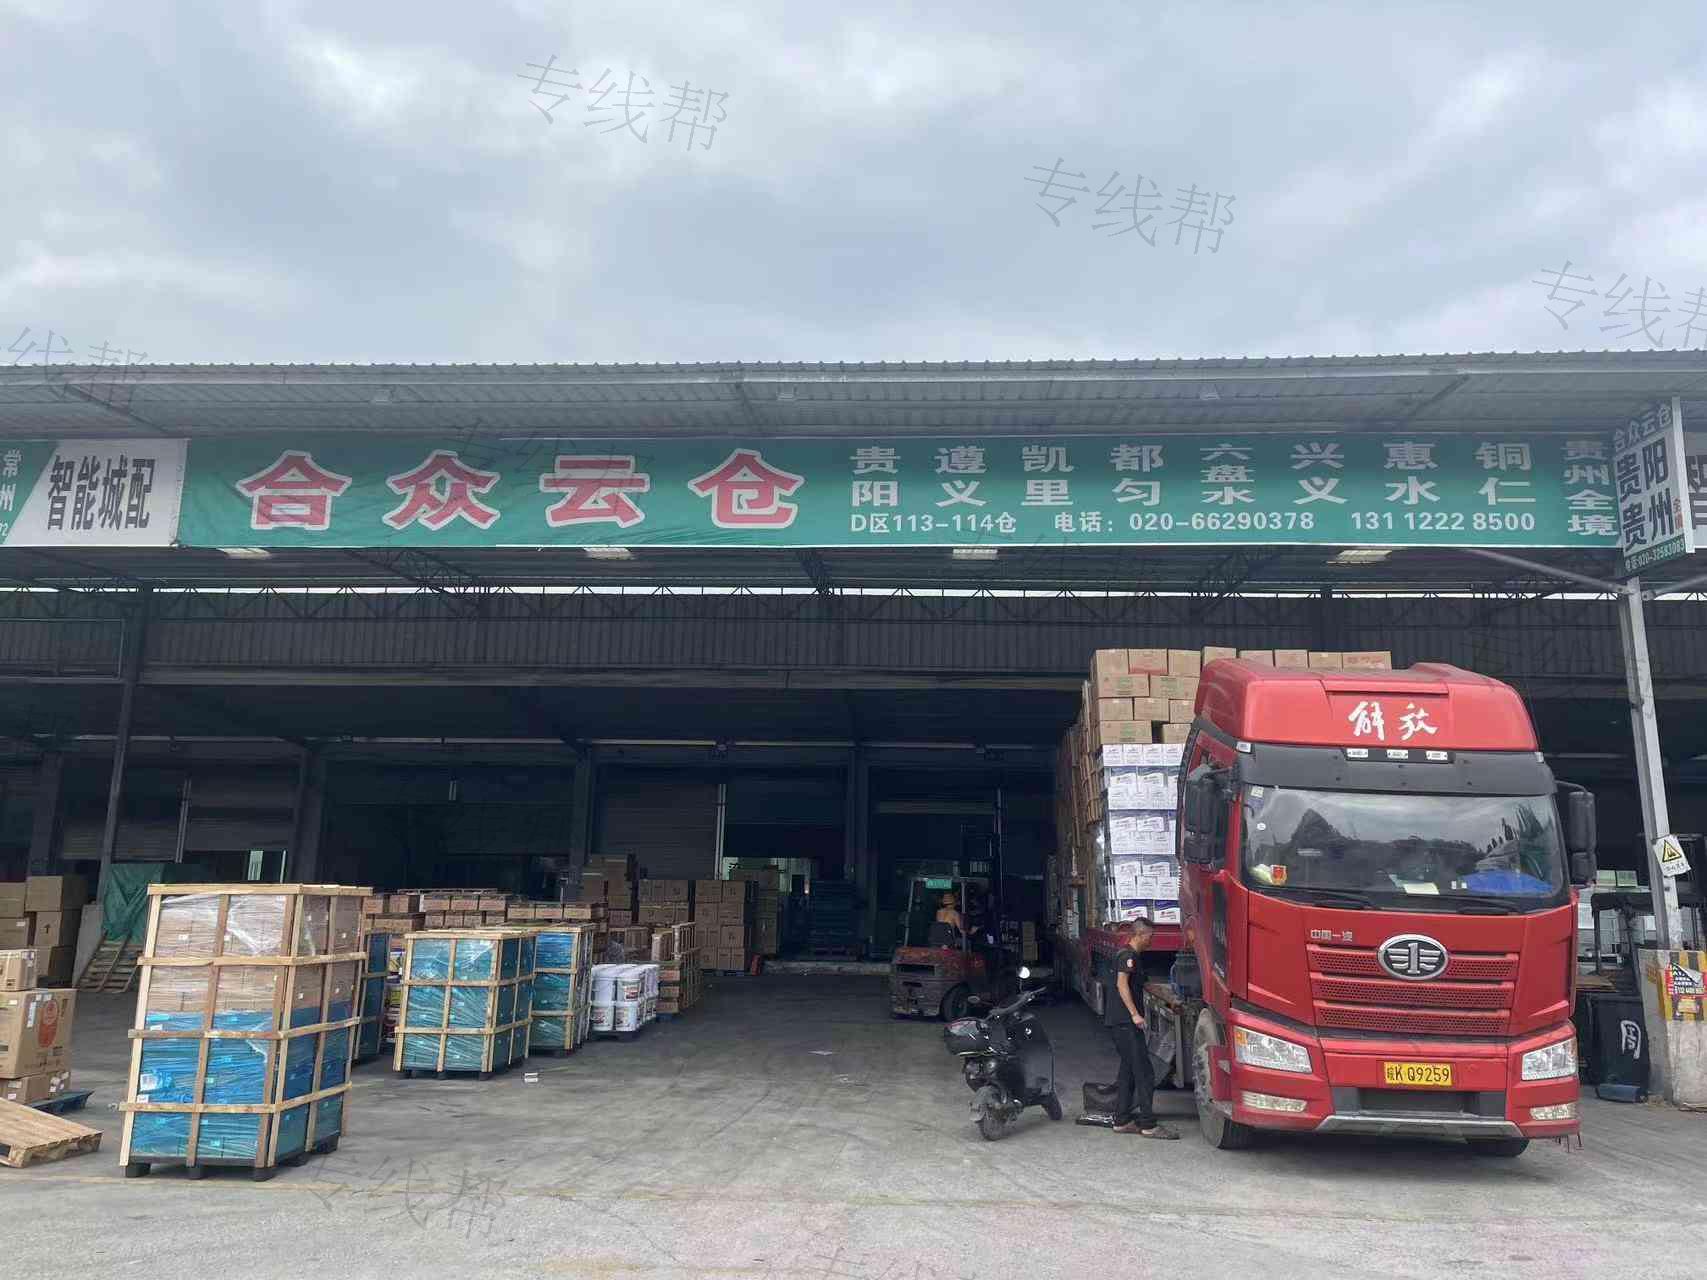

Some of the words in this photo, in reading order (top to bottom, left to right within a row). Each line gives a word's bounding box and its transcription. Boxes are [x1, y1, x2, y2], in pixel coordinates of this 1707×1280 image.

[48, 455, 156, 531] 智能城配
[236, 449, 804, 531] 合众云仓
[850, 446, 900, 507] 贵阳
[934, 446, 987, 507] 遵义
[1021, 445, 1074, 506] 凯里
[1109, 443, 1164, 506] 都匀
[1200, 443, 1255, 505] 六盘水
[1291, 442, 1347, 505] 兴义
[1383, 441, 1440, 505] 惠水
[1475, 442, 1536, 505] 铜仁
[1563, 440, 1618, 535] 贵州全境
[1617, 437, 1669, 501] 贵阳
[851, 512, 1017, 534] D区113-114仓
[1130, 512, 1315, 531] 020-66290378
[1351, 512, 1393, 530] 131
[1404, 512, 1465, 530] 1222
[1472, 512, 1536, 530] 8500
[1623, 488, 1674, 552] 贵州
[1348, 701, 1438, 741] 解放
